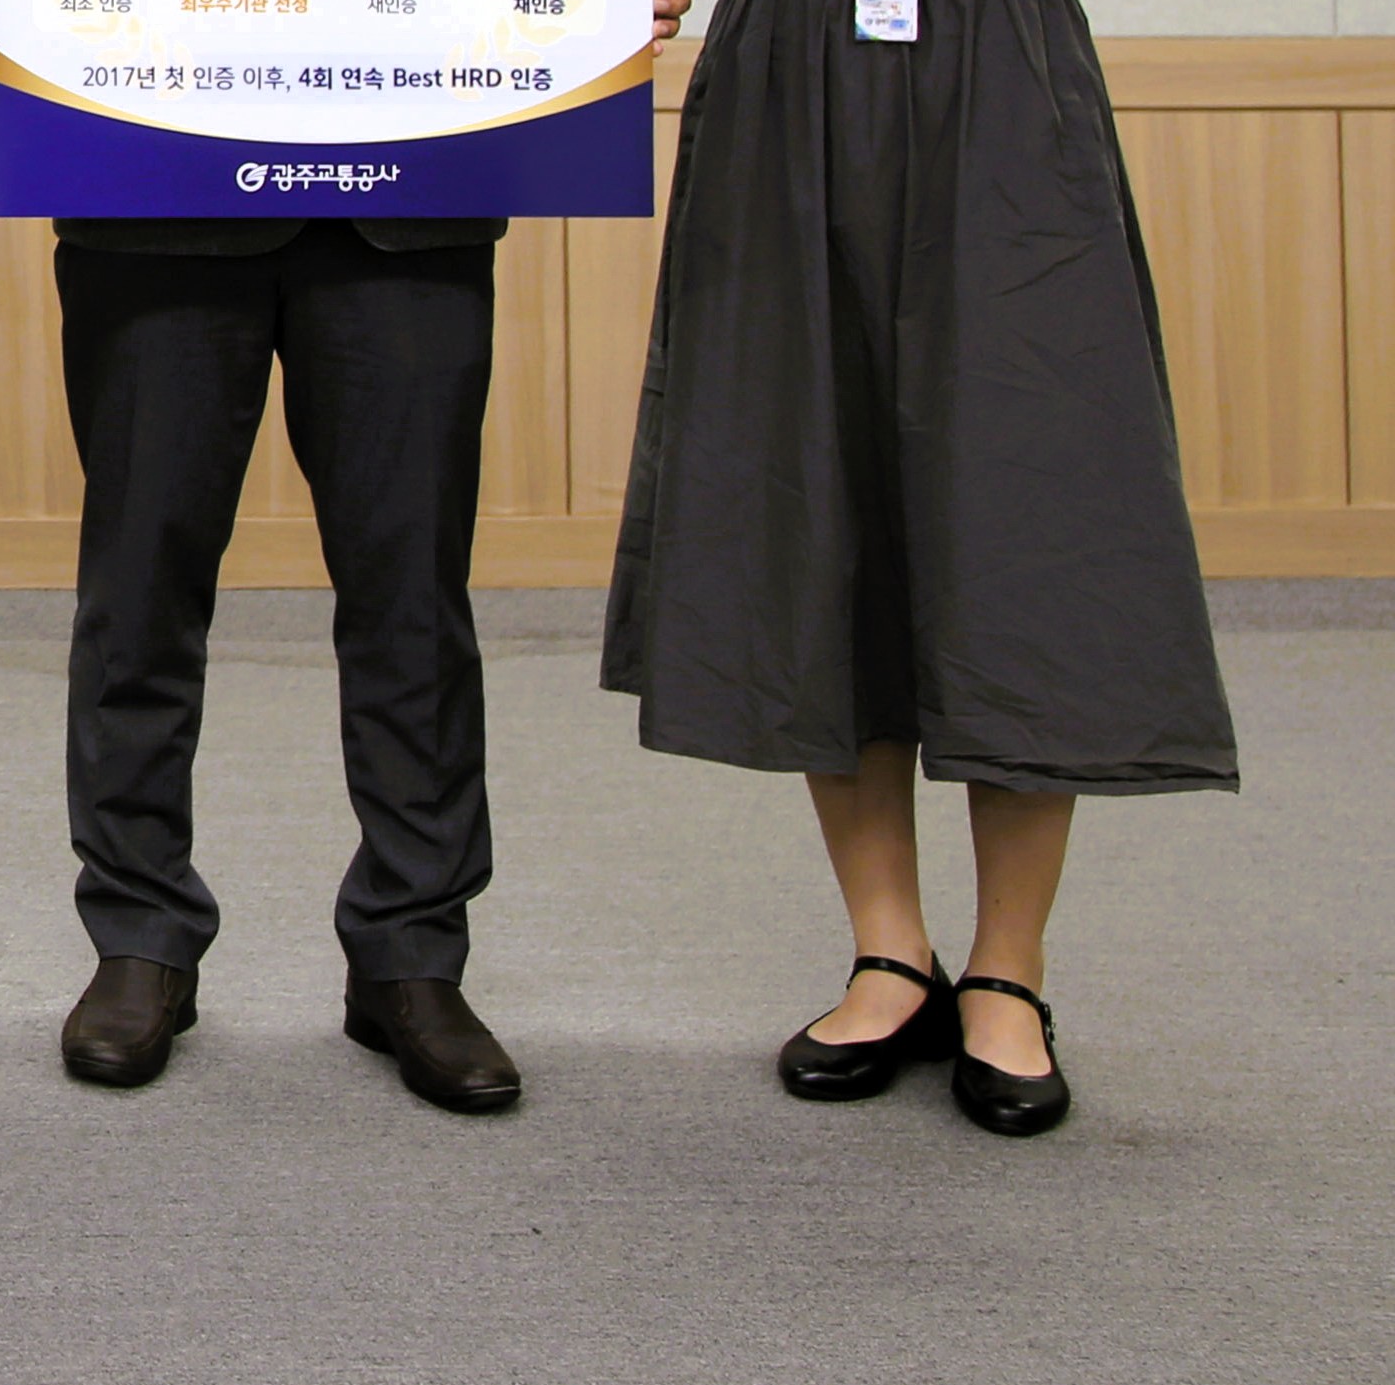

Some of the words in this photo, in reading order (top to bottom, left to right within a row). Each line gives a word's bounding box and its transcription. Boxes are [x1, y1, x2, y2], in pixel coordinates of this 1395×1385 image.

[83, 67, 155, 89] 2017년
[166, 66, 183, 89] 첫
[193, 67, 235, 90] 인증
[243, 67, 290, 91] 이후,
[298, 67, 332, 90] 4회
[341, 67, 384, 90] 연속
[394, 68, 443, 87] Best
[452, 68, 502, 88] HRD
[511, 68, 553, 91] 인증
[271, 164, 400, 191] 광주교통공사
